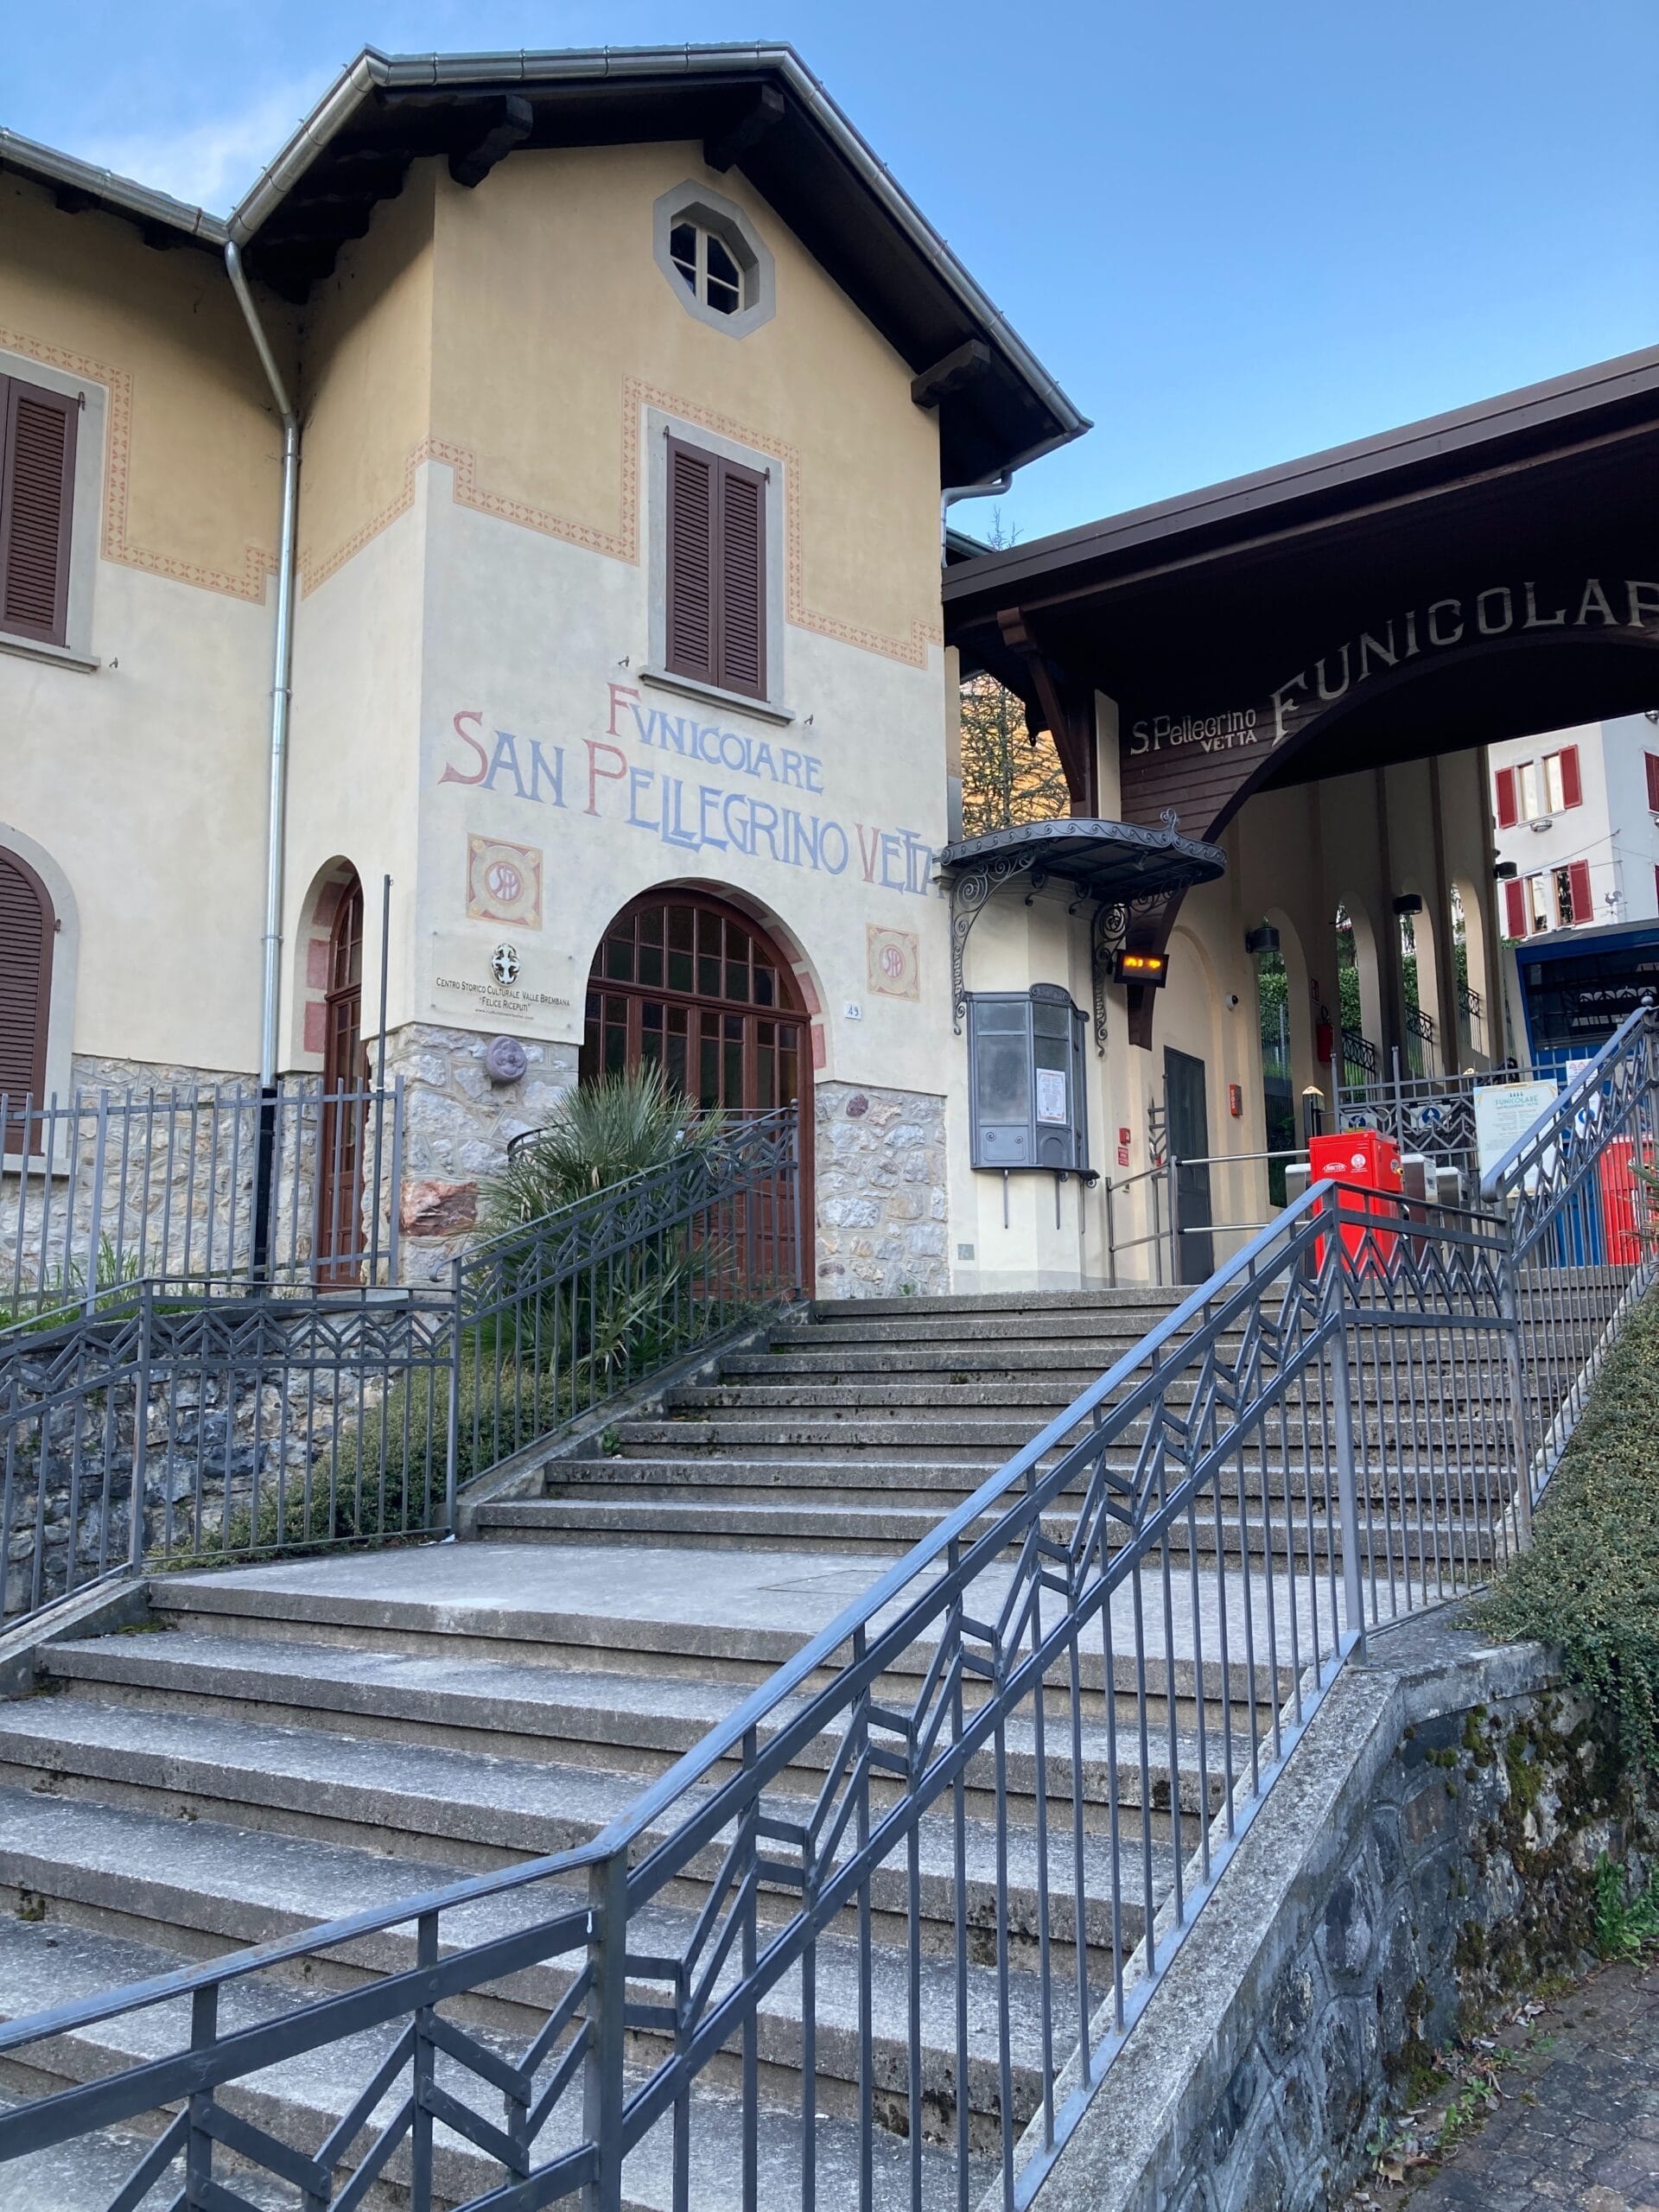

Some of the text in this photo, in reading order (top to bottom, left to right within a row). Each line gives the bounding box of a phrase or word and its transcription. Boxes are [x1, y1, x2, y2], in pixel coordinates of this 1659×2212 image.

[1200, 729, 1258, 753] VETTA
[437, 710, 569, 809] SAN
[581, 738, 849, 875] PELLEGRINO
[435, 977, 570, 1007] CENTRO STORICO CULTURALE VALLE BREMBANA
[848, 1004, 859, 1016] 49
